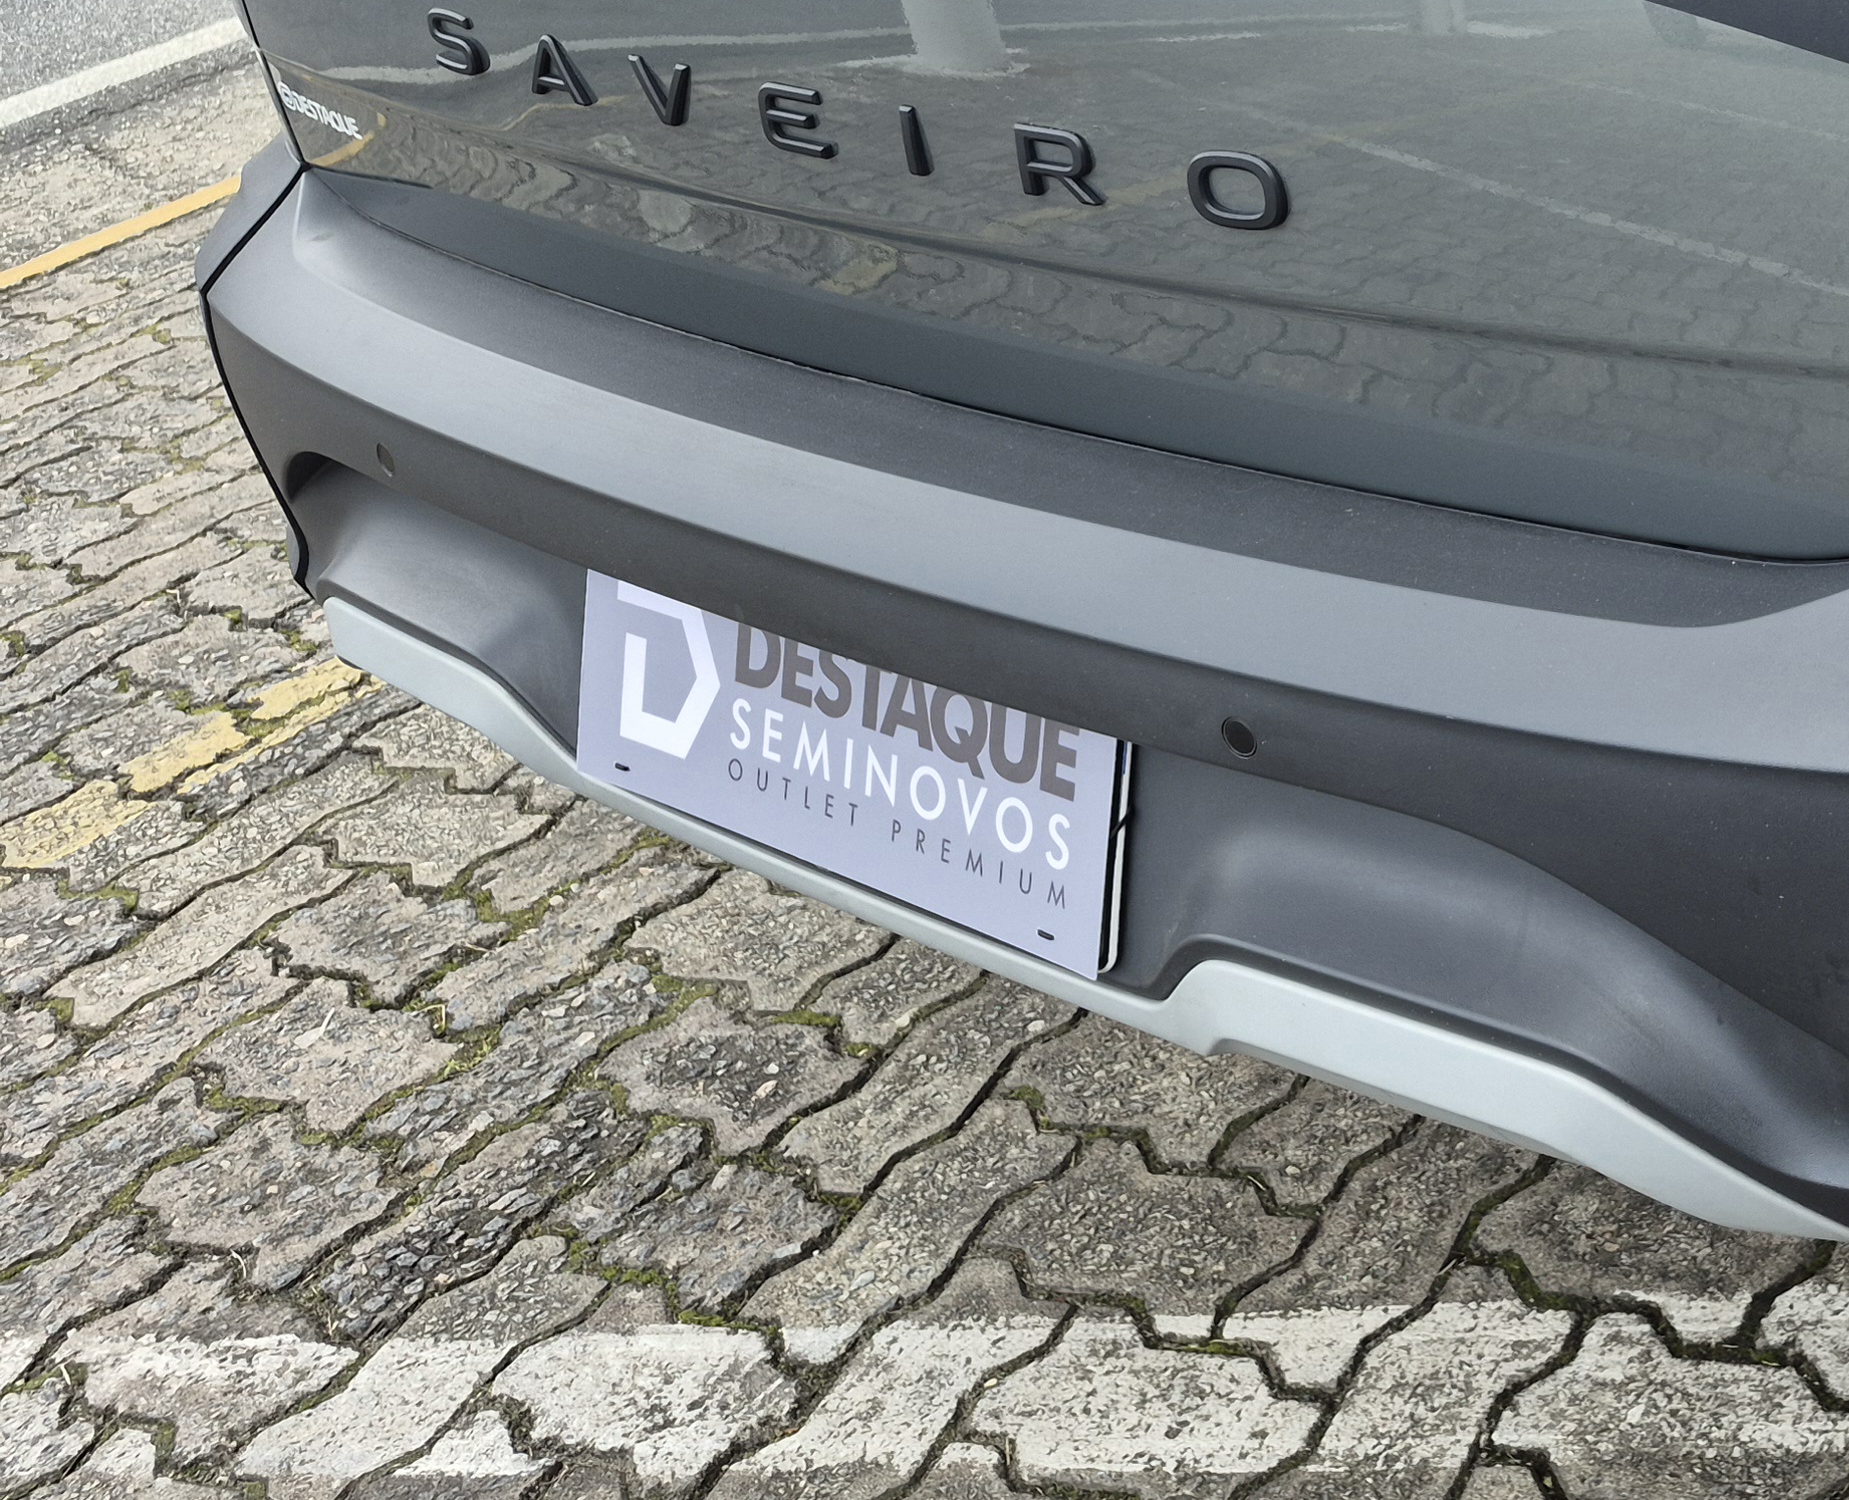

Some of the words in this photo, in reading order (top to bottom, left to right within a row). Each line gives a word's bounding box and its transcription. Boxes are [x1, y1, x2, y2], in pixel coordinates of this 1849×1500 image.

[427, 7, 1291, 231] SAVEIRO
[728, 757, 860, 828] OUTLET
[891, 821, 1067, 910] PREMIUM
[729, 697, 1070, 870] SEMINOVOS
